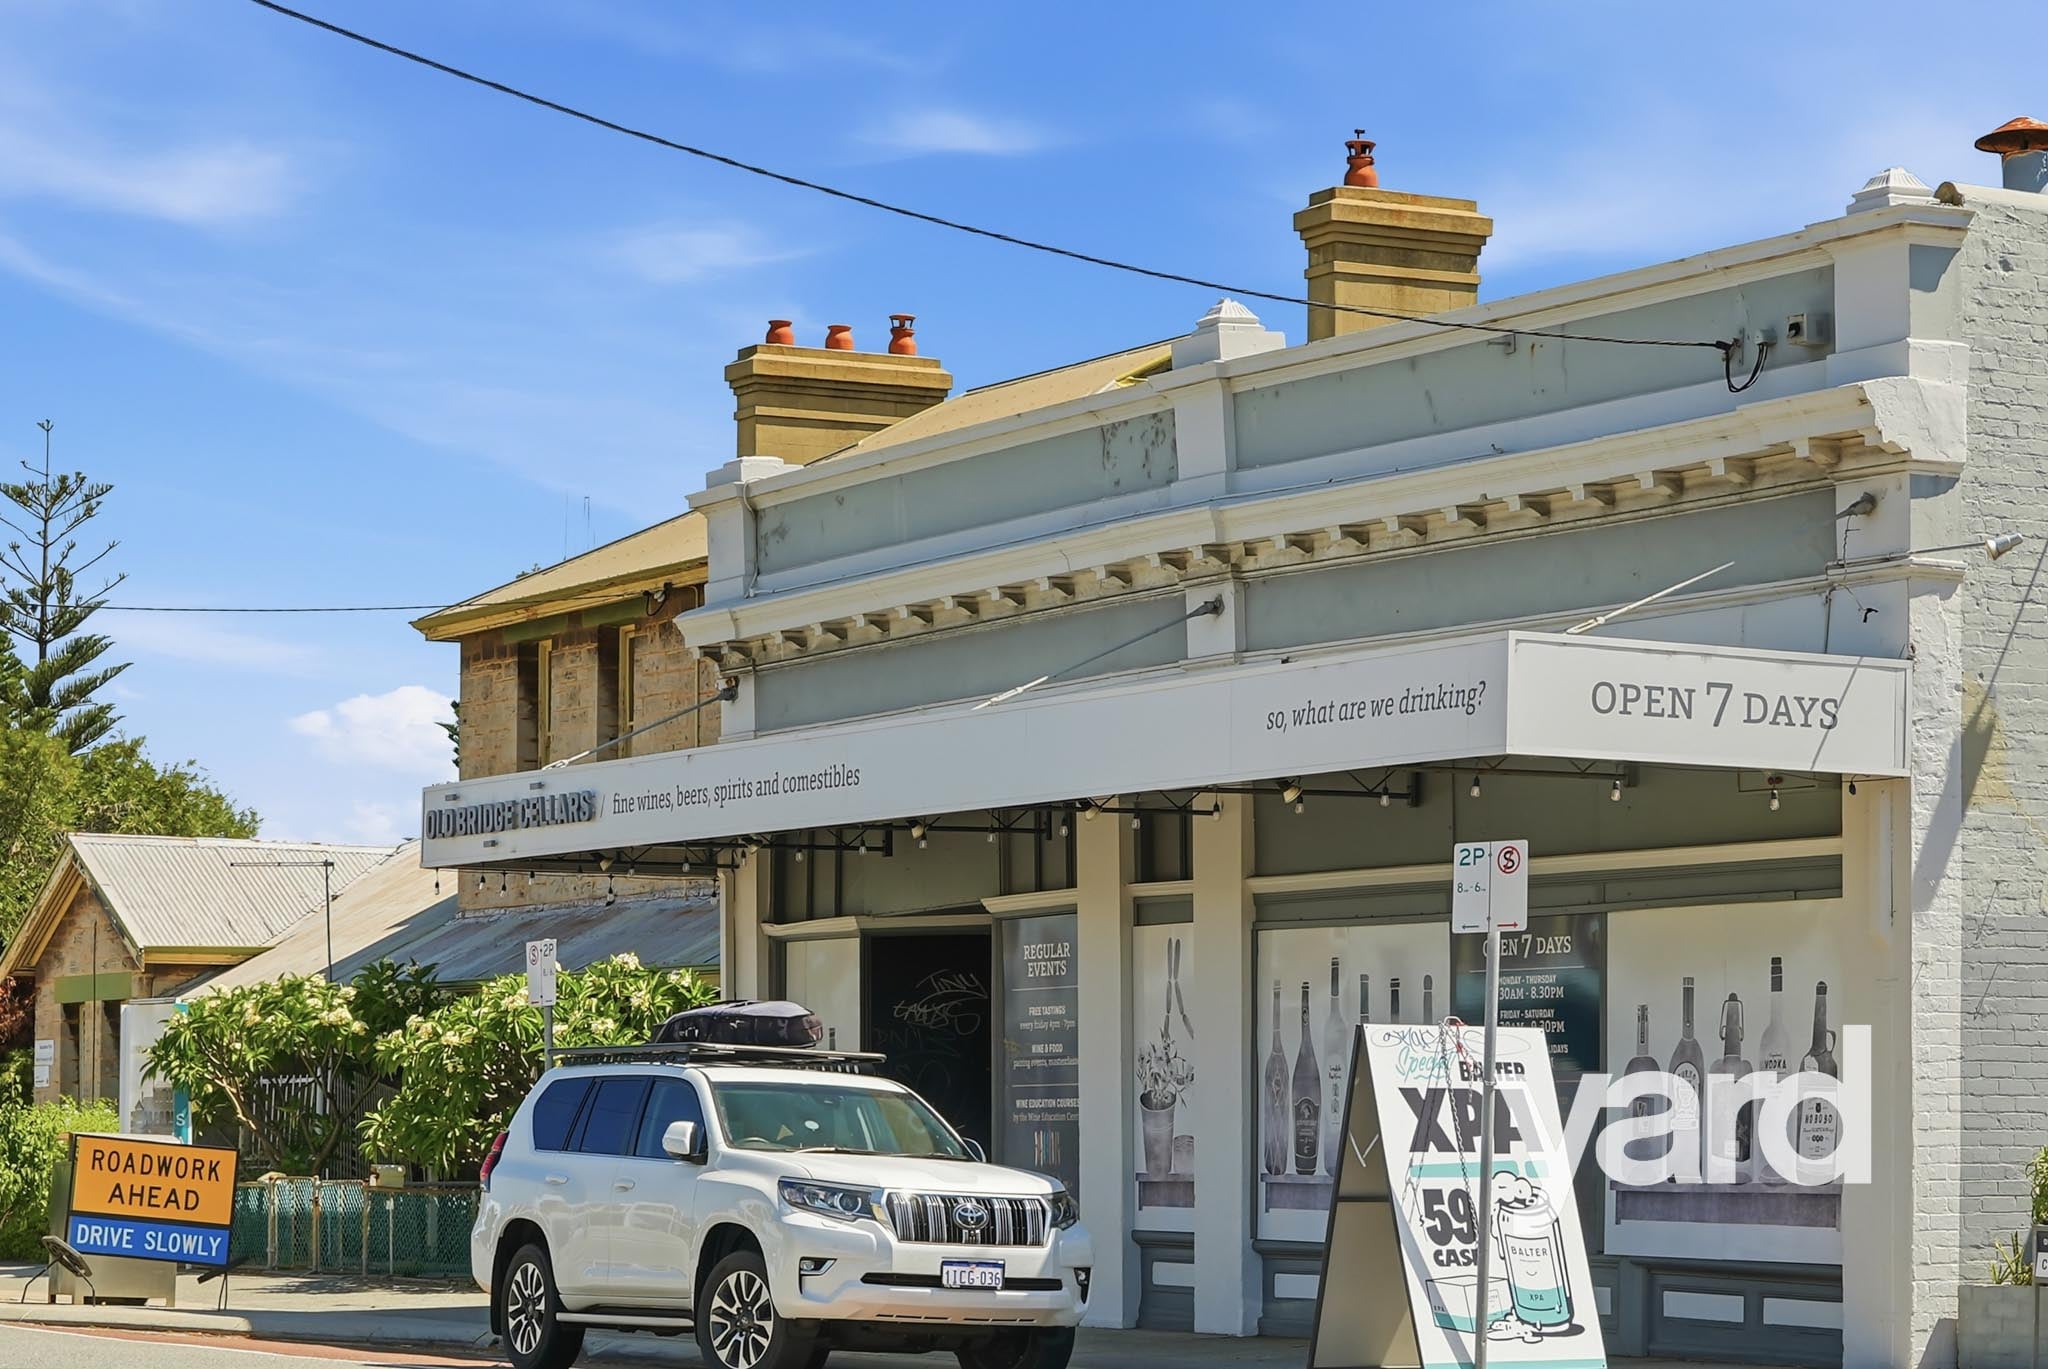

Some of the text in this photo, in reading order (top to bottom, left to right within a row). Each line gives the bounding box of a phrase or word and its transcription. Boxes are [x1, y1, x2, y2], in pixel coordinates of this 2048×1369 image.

[1266, 680, 1487, 733] so, what are we drinking?
[1591, 680, 1841, 731] OPEN 7 DAYS
[426, 809, 456, 839] OLD
[456, 800, 518, 836] BRIDGE
[520, 791, 596, 828] CELLARS
[612, 793, 635, 815] fine
[637, 790, 674, 813] wines,
[676, 785, 711, 808] beers,
[713, 777, 753, 808] spirits
[755, 771, 780, 797] and
[782, 763, 861, 794] comestibles
[1459, 848, 1485, 866] 2P
[1024, 942, 1071, 960] REGULAR
[1521, 934, 1532, 959] 7
[1536, 936, 1571, 954] DAYS
[1028, 960, 1067, 977] EVENTS
[1526, 974, 1557, 984] THURSDAY
[1530, 986, 1564, 999] 8.30PM
[1500, 1009, 1520, 1019] FRIDAY
[1525, 1009, 1555, 1018] SATURDAY
[1459, 1060, 1526, 1082] BATER
[1764, 1059, 1787, 1069] VODKA
[1399, 1087, 1545, 1153] XPA
[91, 1149, 220, 1182] ROADWORK
[108, 1183, 200, 1211] AHEAD
[76, 1224, 134, 1249] DRIVE
[144, 1230, 222, 1257] SLOWLY
[1511, 1246, 1548, 1257] BALTER
[1529, 1293, 1544, 1301] XPA
